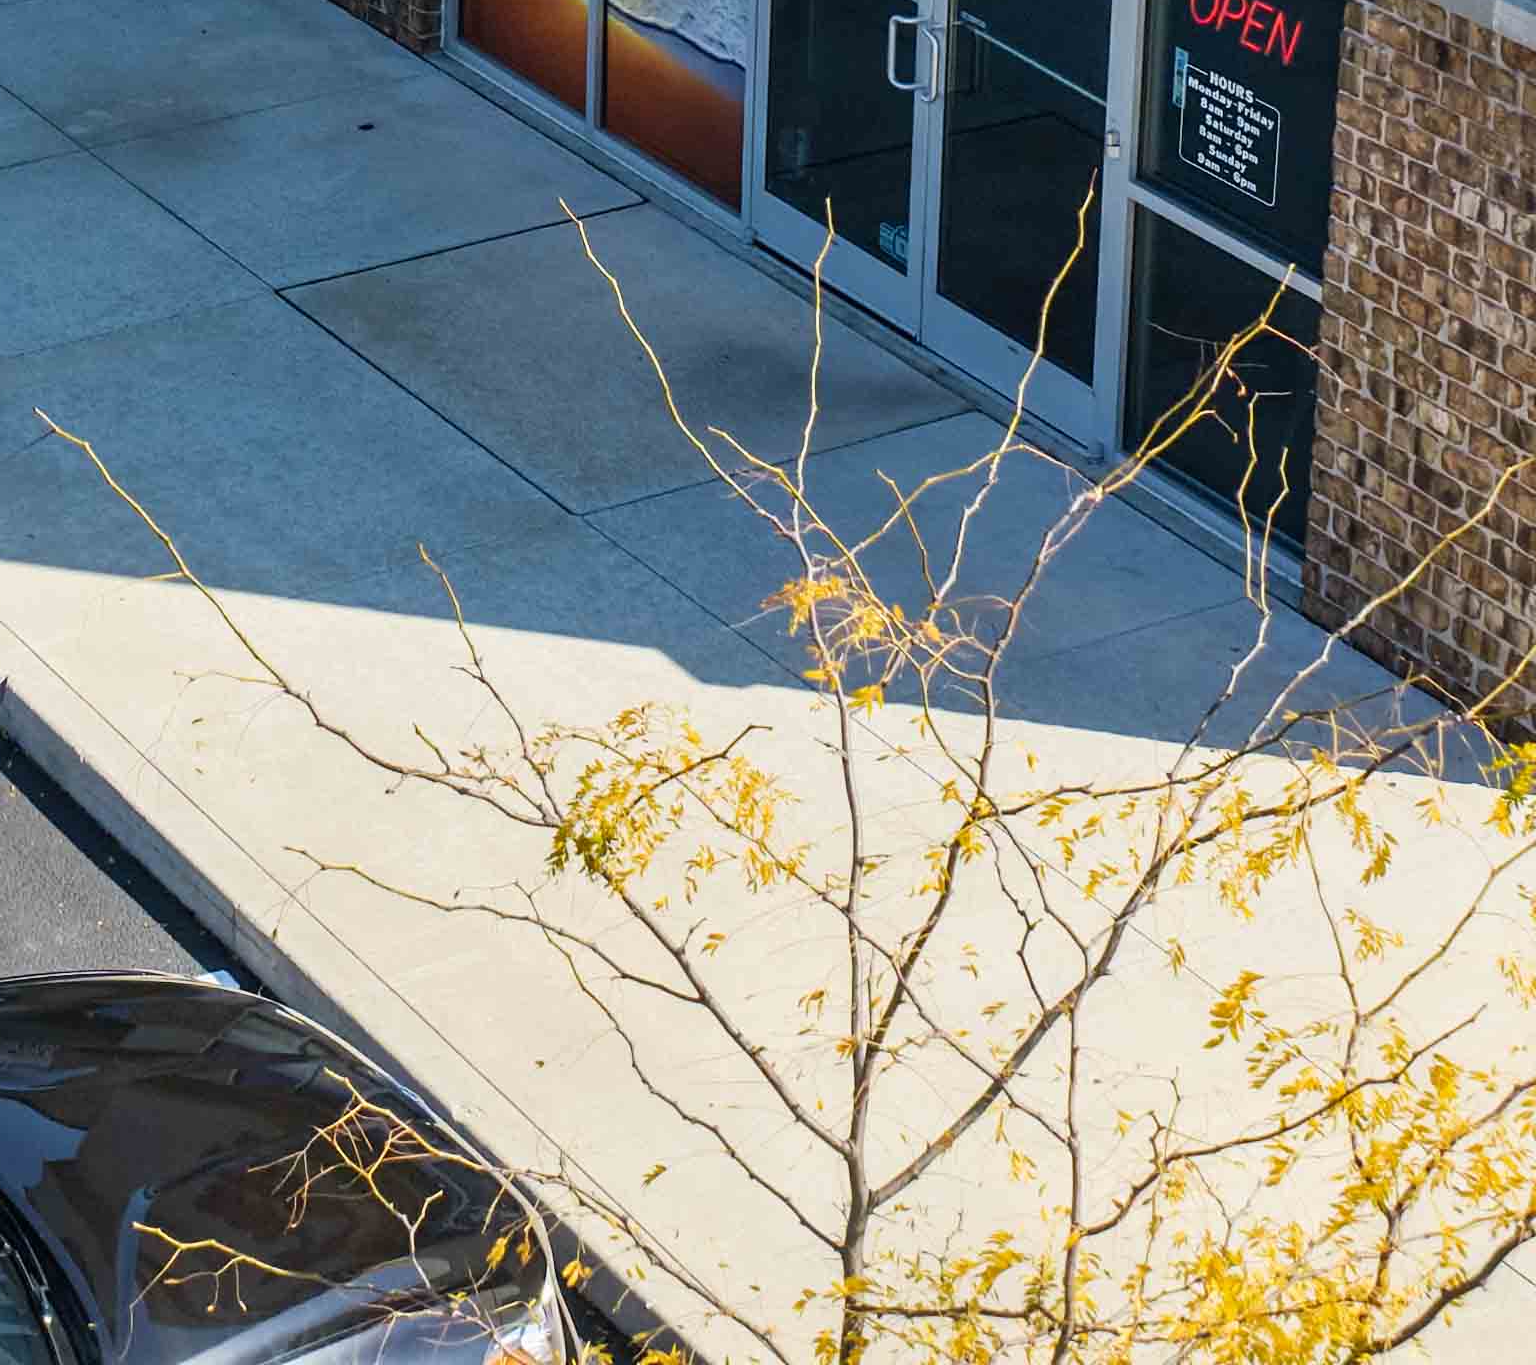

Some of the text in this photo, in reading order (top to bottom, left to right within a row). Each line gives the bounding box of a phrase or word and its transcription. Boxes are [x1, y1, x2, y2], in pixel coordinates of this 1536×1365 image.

[1187, 76, 1275, 131] Monday-Friday
[1209, 71, 1255, 104] HOURS
[1200, 97, 1224, 118] 8am
[1236, 116, 1261, 138] 9pm
[1205, 114, 1254, 149] Saturday
[1199, 124, 1222, 145] 8am
[1234, 143, 1259, 165] 6pm
[1208, 144, 1247, 174] Sunday
[1197, 152, 1221, 173] 9am
[1233, 171, 1257, 193] 6pm
